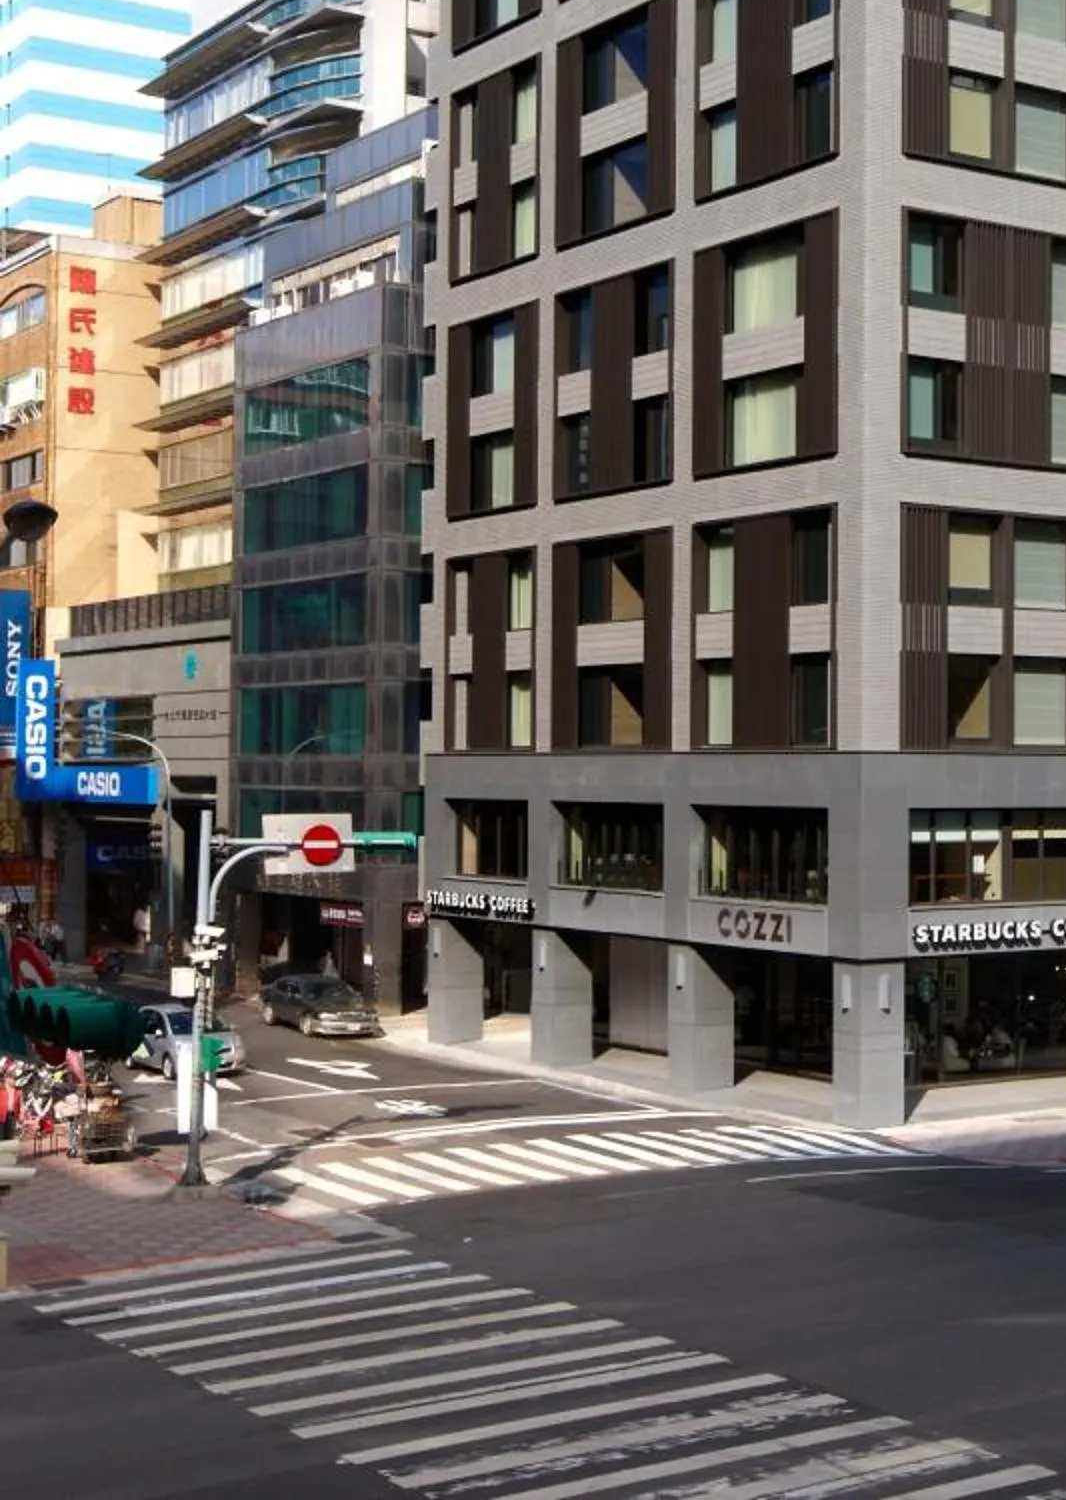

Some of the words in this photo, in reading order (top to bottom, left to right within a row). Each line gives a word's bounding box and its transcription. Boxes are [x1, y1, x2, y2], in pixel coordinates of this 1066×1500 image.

[6, 620, 23, 696] SONY
[25, 675, 47, 780] CASIO
[77, 771, 121, 796] CASIO
[489, 893, 529, 913] COFFEE
[718, 908, 793, 943] COZZI
[915, 920, 1042, 943] STARBUCKS
